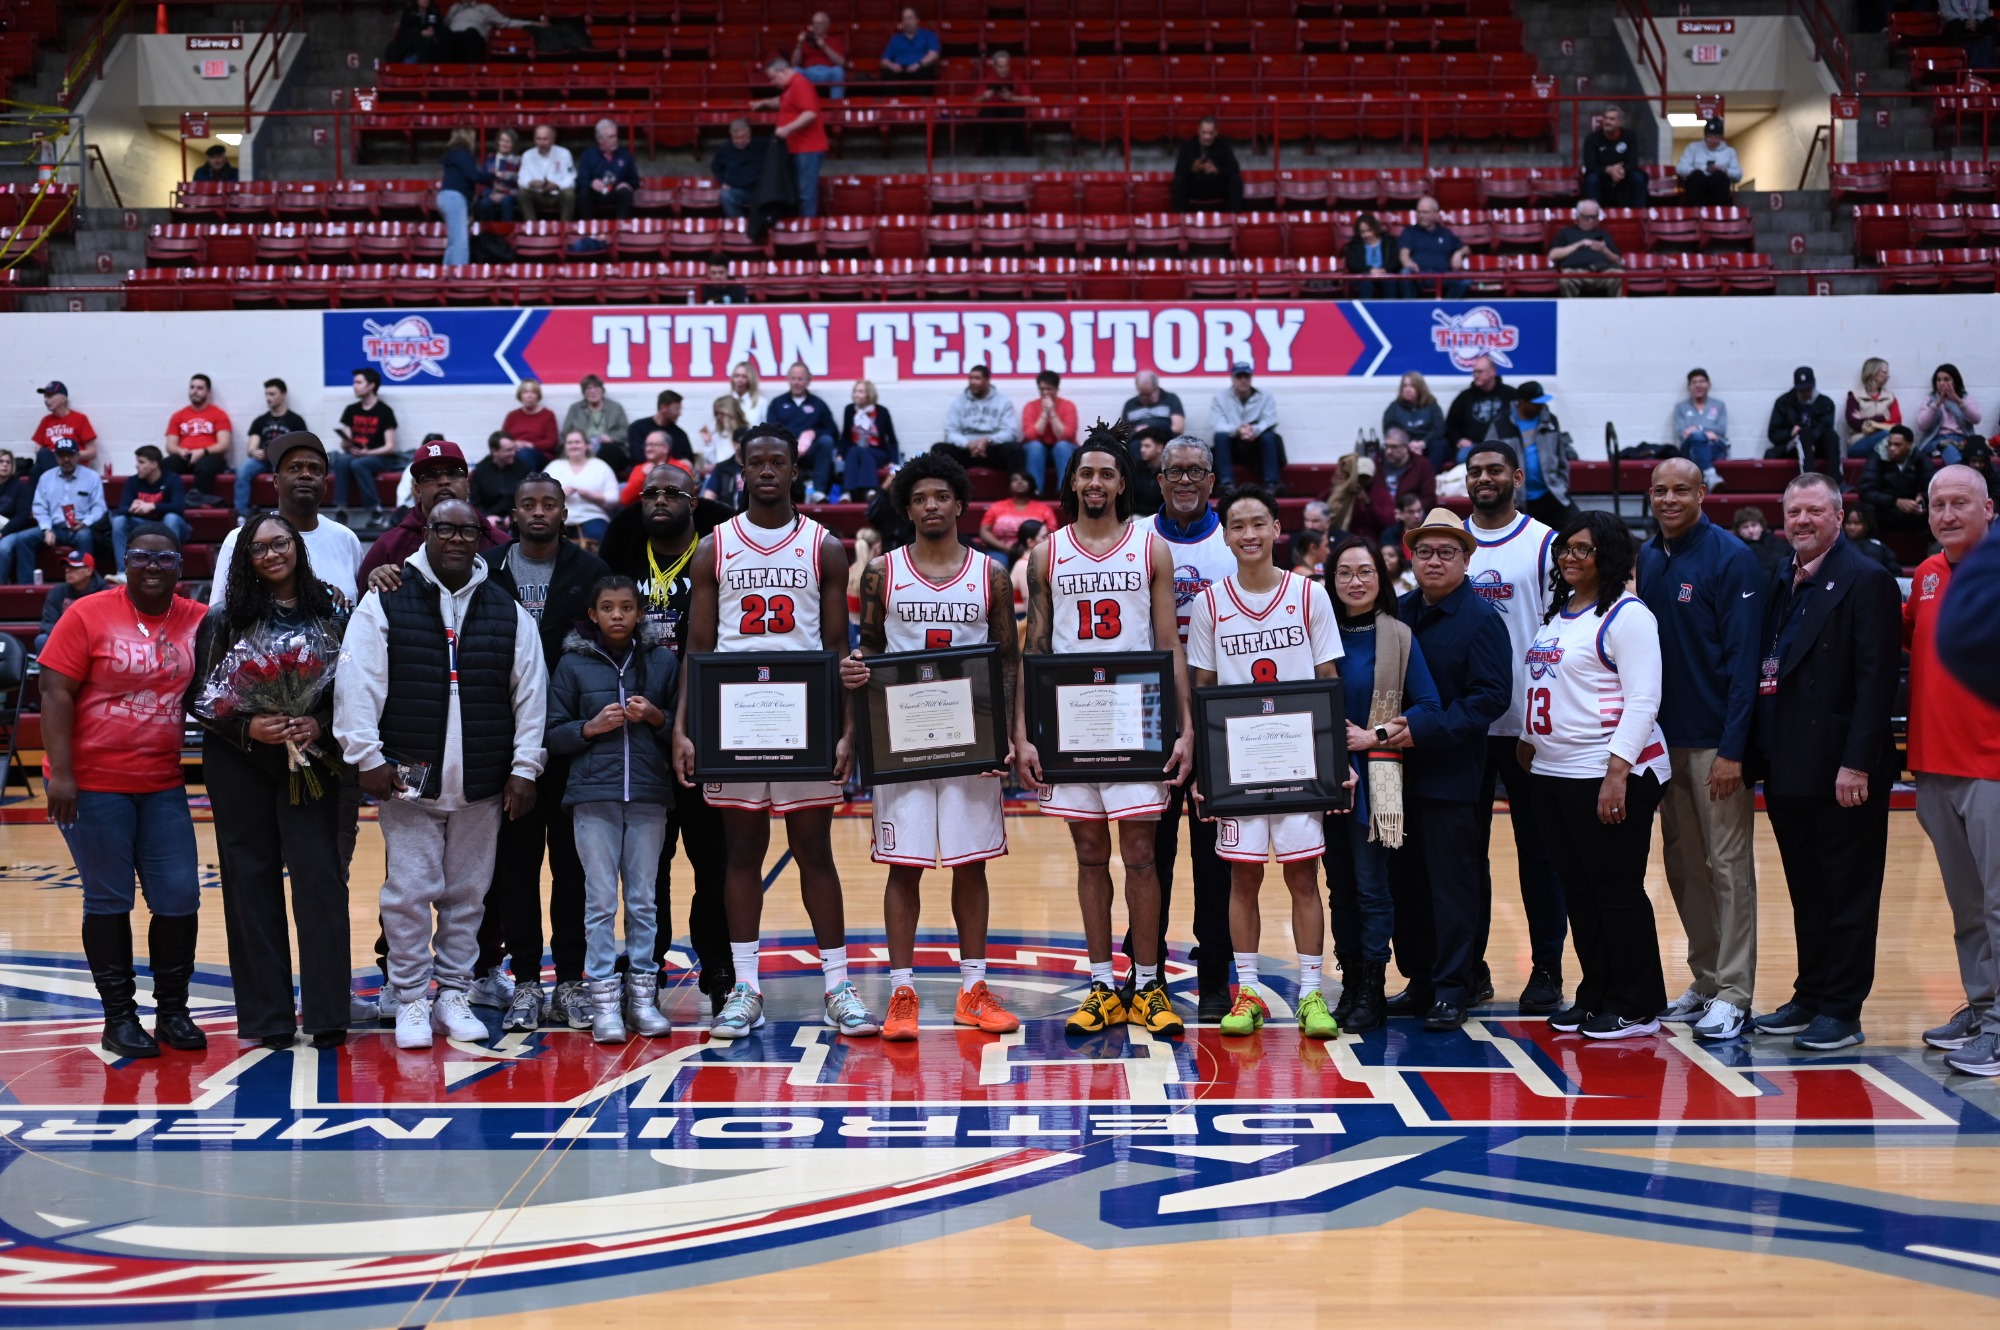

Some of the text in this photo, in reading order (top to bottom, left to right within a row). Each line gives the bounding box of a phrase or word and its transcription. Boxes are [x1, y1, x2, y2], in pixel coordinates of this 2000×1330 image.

[1681, 22, 1721, 33] Stairway
[190, 38, 229, 49] Stairway
[1697, 45, 1717, 62] EXIT
[204, 60, 225, 77] EXIT
[1790, 236, 1804, 253] C
[98, 254, 111, 272] C
[367, 338, 445, 358] TITANS
[592, 308, 1305, 378] TITAN TERRITORY
[1436, 330, 1514, 348] TITANS
[728, 568, 808, 590] TITANS
[1058, 572, 1141, 595] TITANS
[1174, 580, 1211, 594] TANS
[1474, 585, 1513, 600] TANS
[740, 594, 795, 634] 23
[897, 602, 979, 622] TITANS
[1077, 598, 1122, 639] 13
[925, 629, 952, 649] 5
[1221, 626, 1304, 656] TITANS
[1526, 649, 1563, 664] TITANS
[1251, 658, 1278, 683] 8
[756, 700, 773, 708] Hill
[774, 700, 795, 708] Classics
[899, 702, 920, 710] Church
[921, 700, 937, 708] Hill
[1068, 700, 1090, 708] Church
[1091, 699, 1107, 707] Hill
[1526, 687, 1553, 735] 13
[1240, 734, 1262, 742] Church
[1262, 732, 1280, 740] Hill
[0, 1113, 1347, 1140] DETROIT MER
